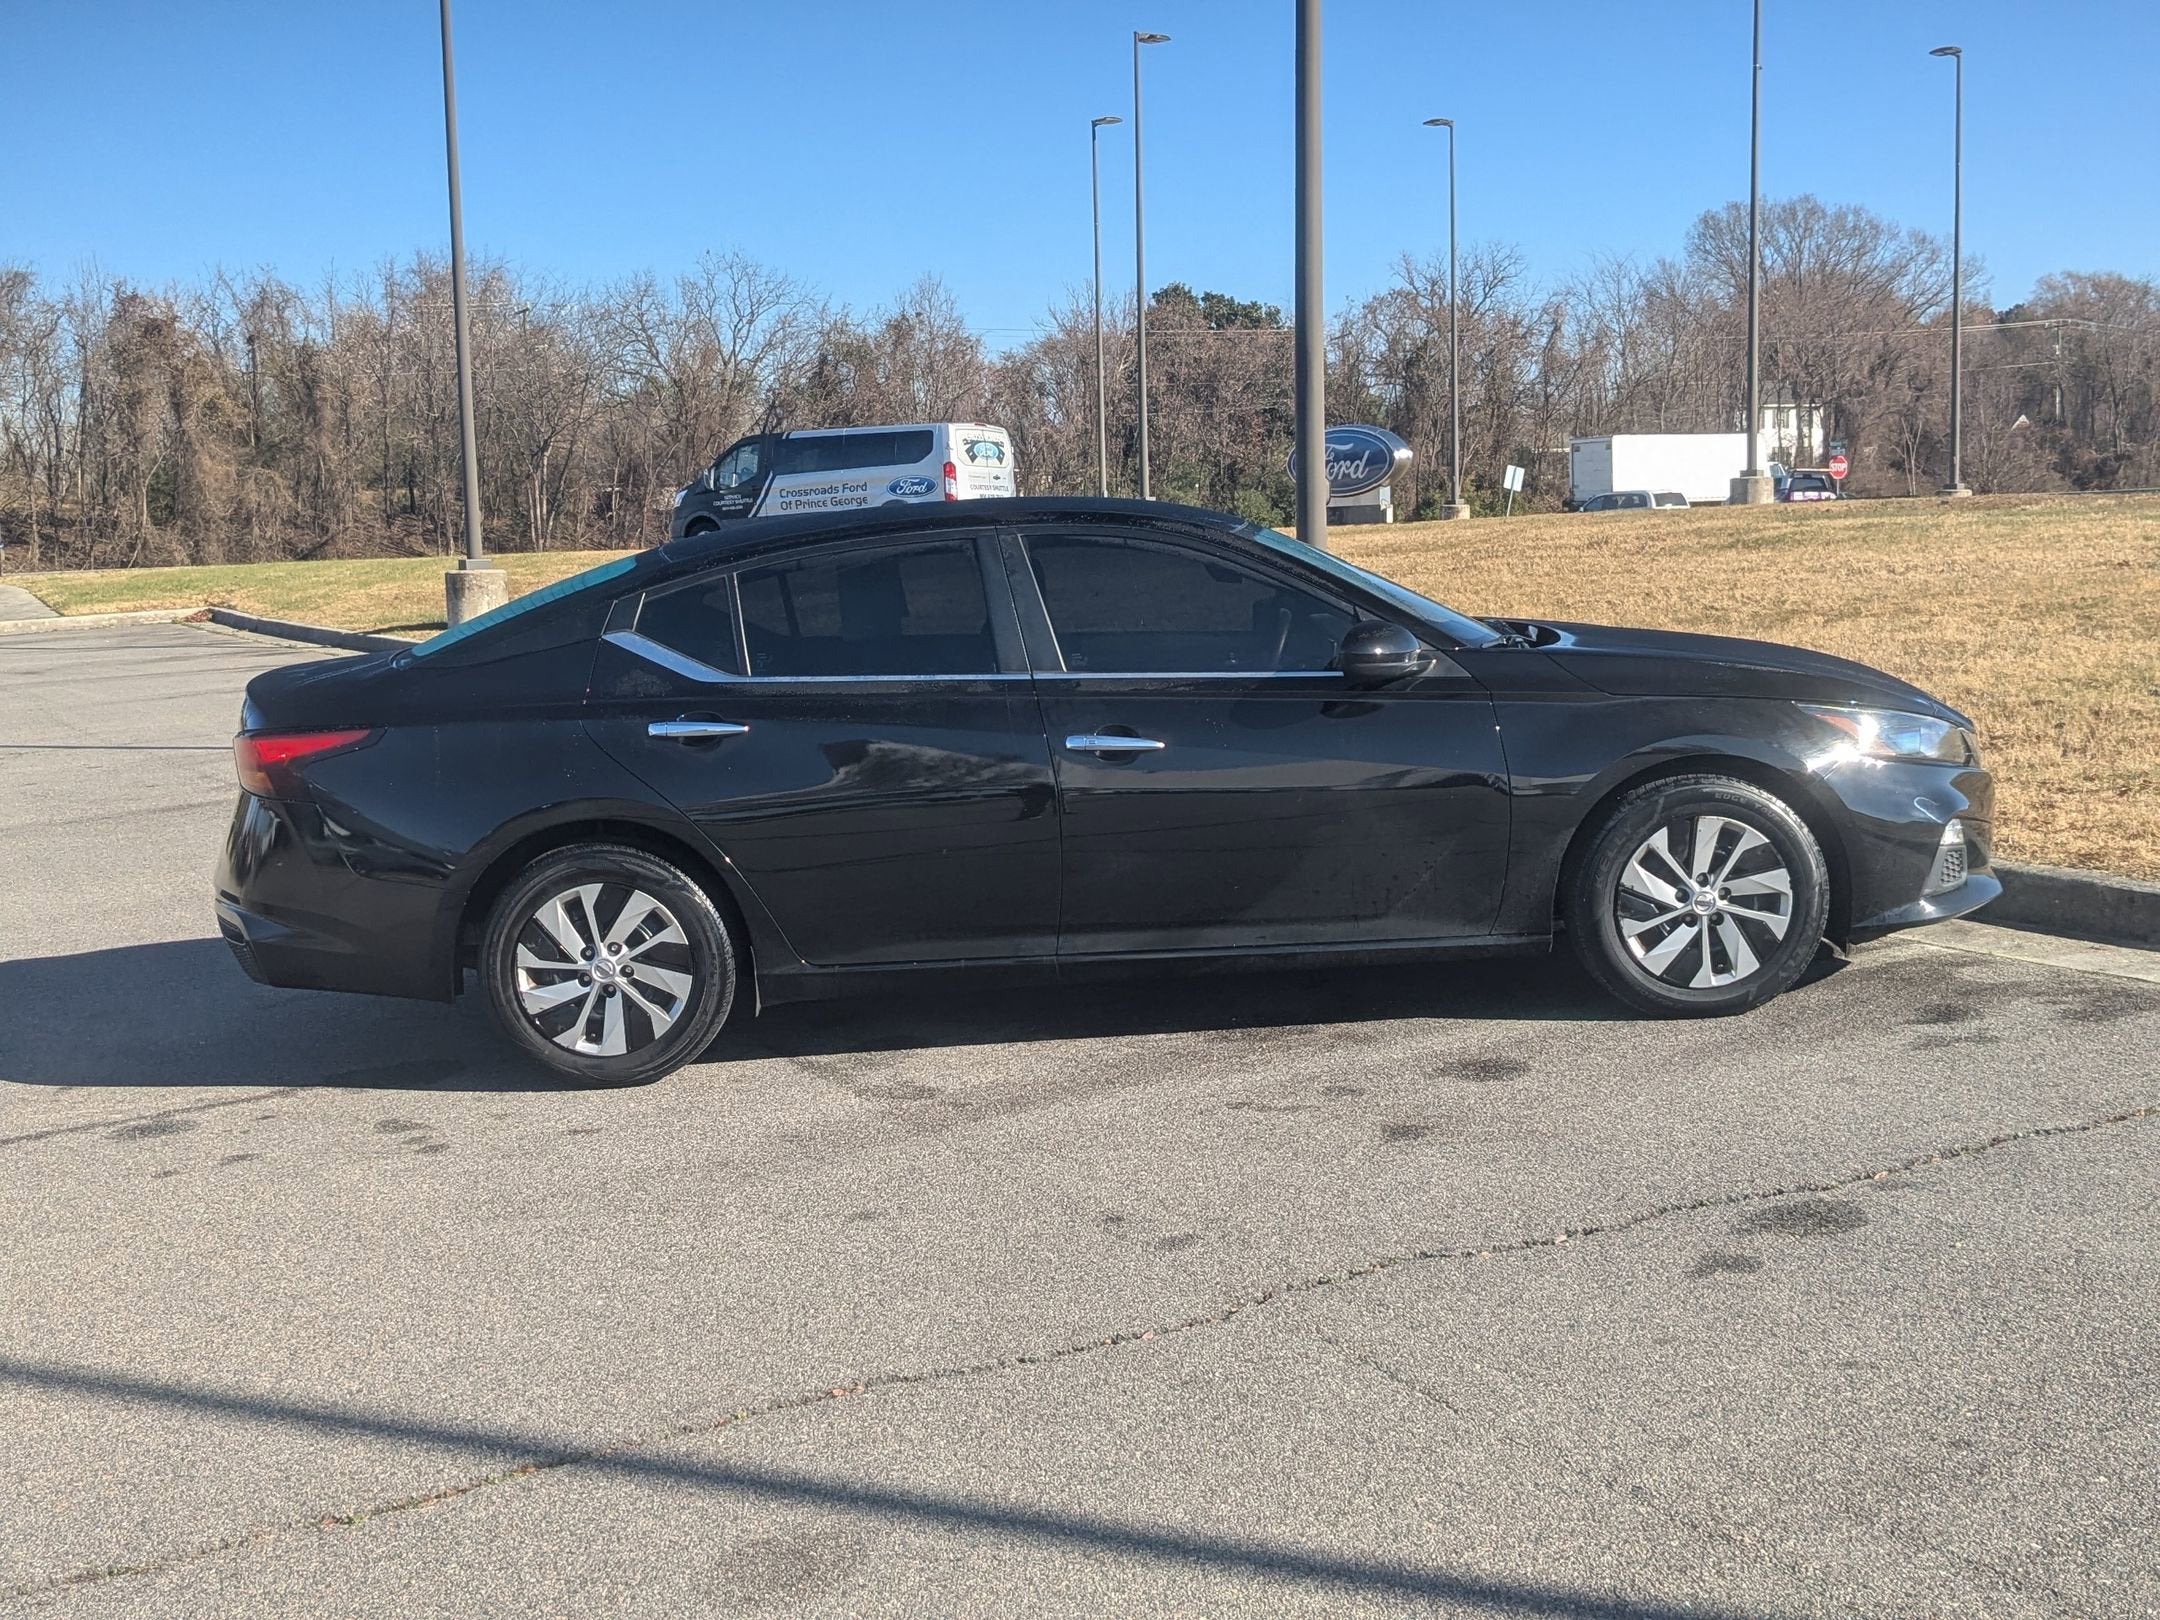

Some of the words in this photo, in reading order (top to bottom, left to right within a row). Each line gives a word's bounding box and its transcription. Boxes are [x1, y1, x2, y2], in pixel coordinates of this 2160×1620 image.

[1831, 463, 1847, 472] STOP
[779, 485, 840, 498] Crossroads
[842, 482, 868, 494] Ford
[896, 478, 928, 494] Ford
[780, 500, 793, 511] Of
[795, 498, 828, 510] Prince
[830, 496, 868, 507] George
